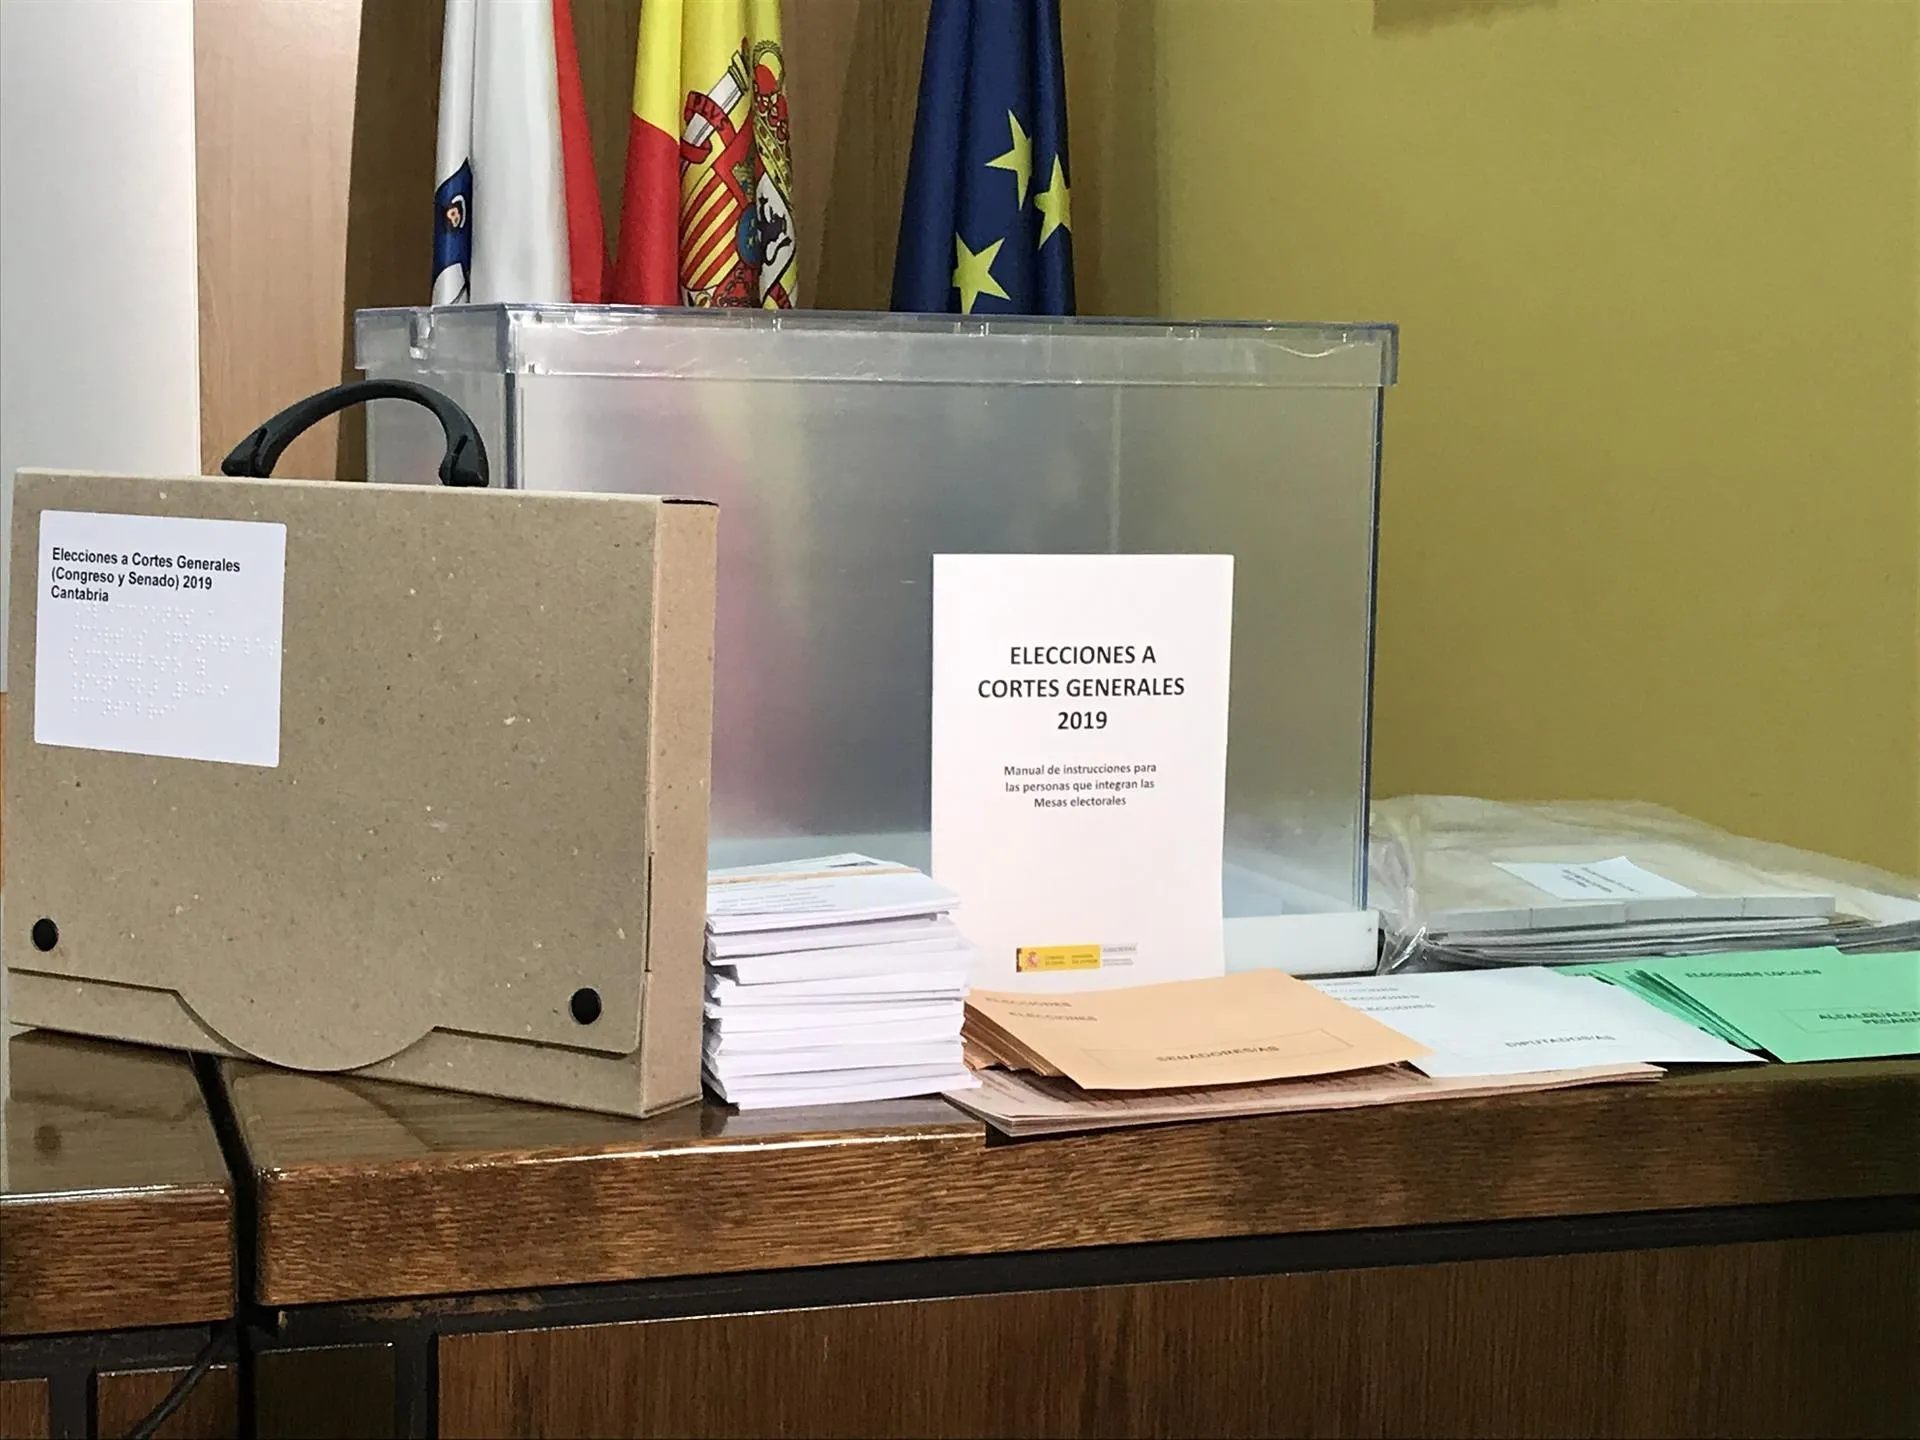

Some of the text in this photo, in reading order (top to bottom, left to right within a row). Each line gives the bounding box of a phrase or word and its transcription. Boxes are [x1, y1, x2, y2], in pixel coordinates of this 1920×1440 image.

[52, 547, 241, 573] Elecciones a Cortes Generales
[51, 566, 213, 591] (Congreso y Senado) 2019
[51, 585, 109, 602] Cantabria
[1010, 646, 1157, 665] ELECCIONES A
[978, 678, 1185, 699] CORTES GENERALES
[1057, 711, 1108, 730] 2019
[1004, 763, 1157, 778] Manual de instrucciones para
[1005, 779, 1155, 795] las personas que integran las
[1033, 796, 1127, 808] Mesas electorales
